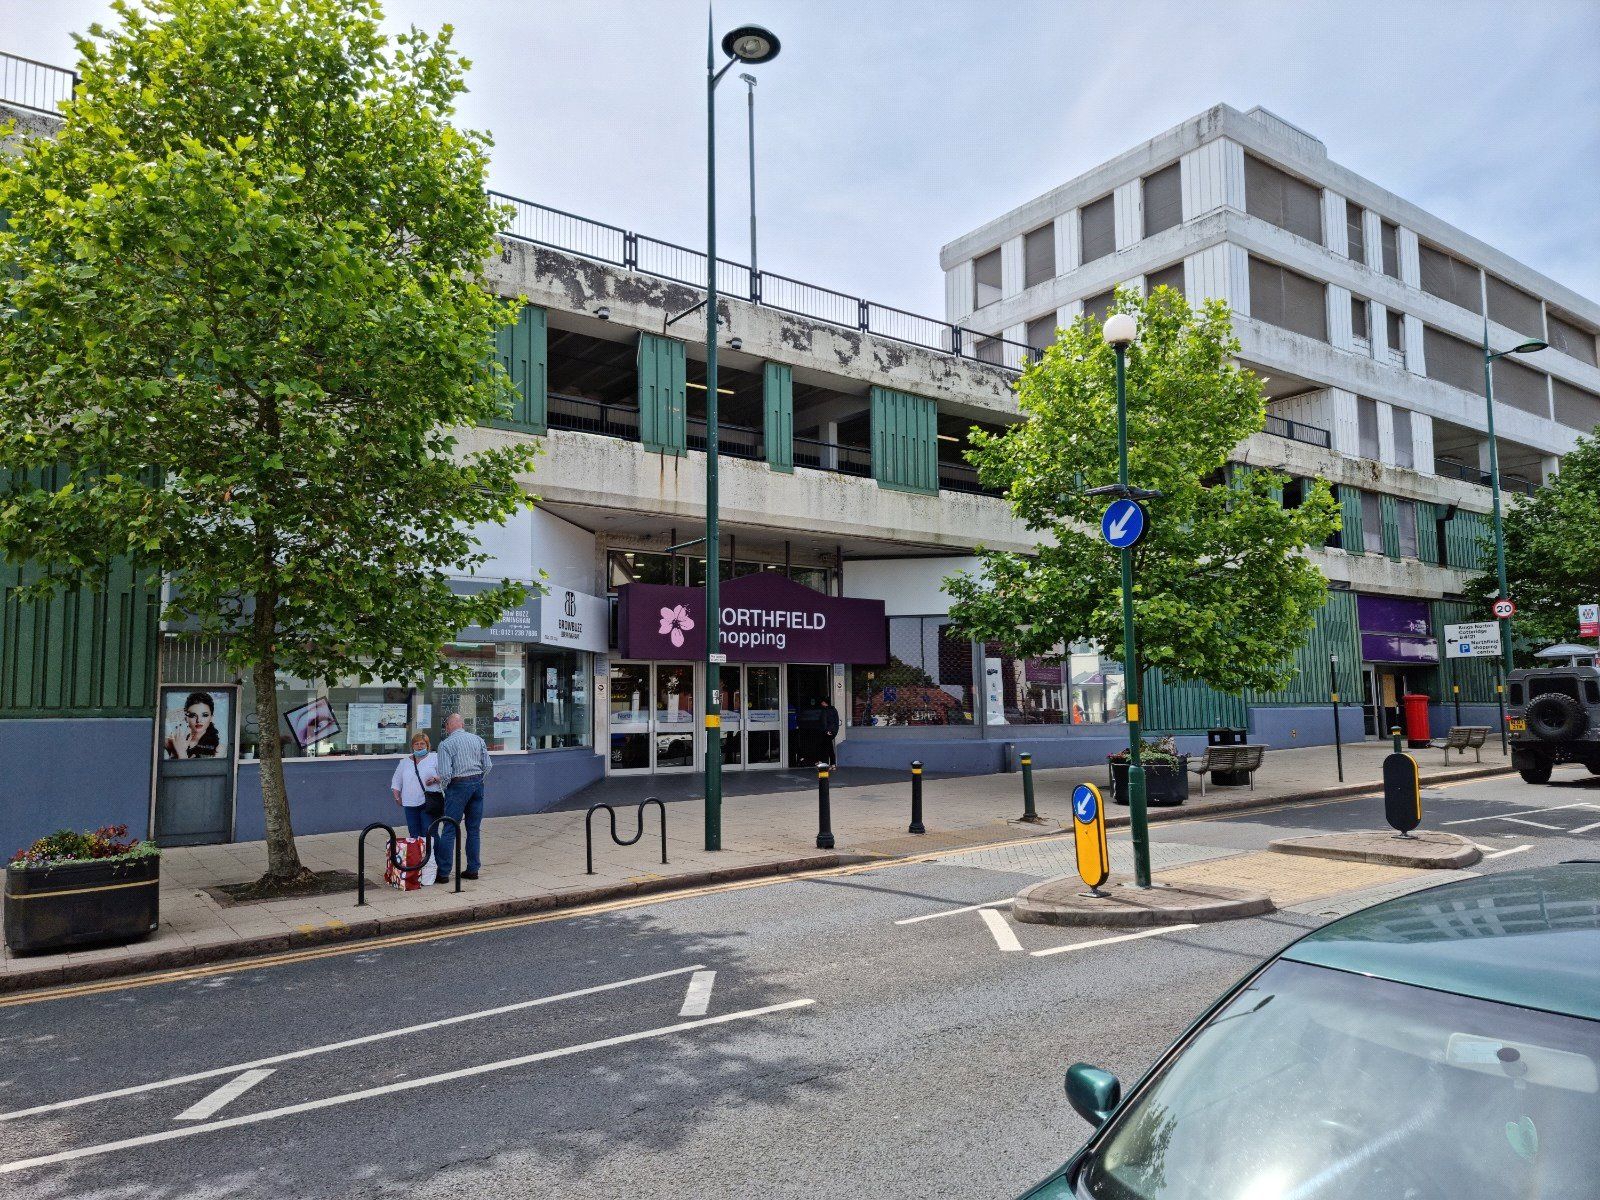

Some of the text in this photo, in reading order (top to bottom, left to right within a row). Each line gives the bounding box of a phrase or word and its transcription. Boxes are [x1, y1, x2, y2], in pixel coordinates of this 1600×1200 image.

[718, 607, 826, 630] ORTHFIELD
[1496, 604, 1512, 613] 20
[718, 628, 787, 650] hopping
